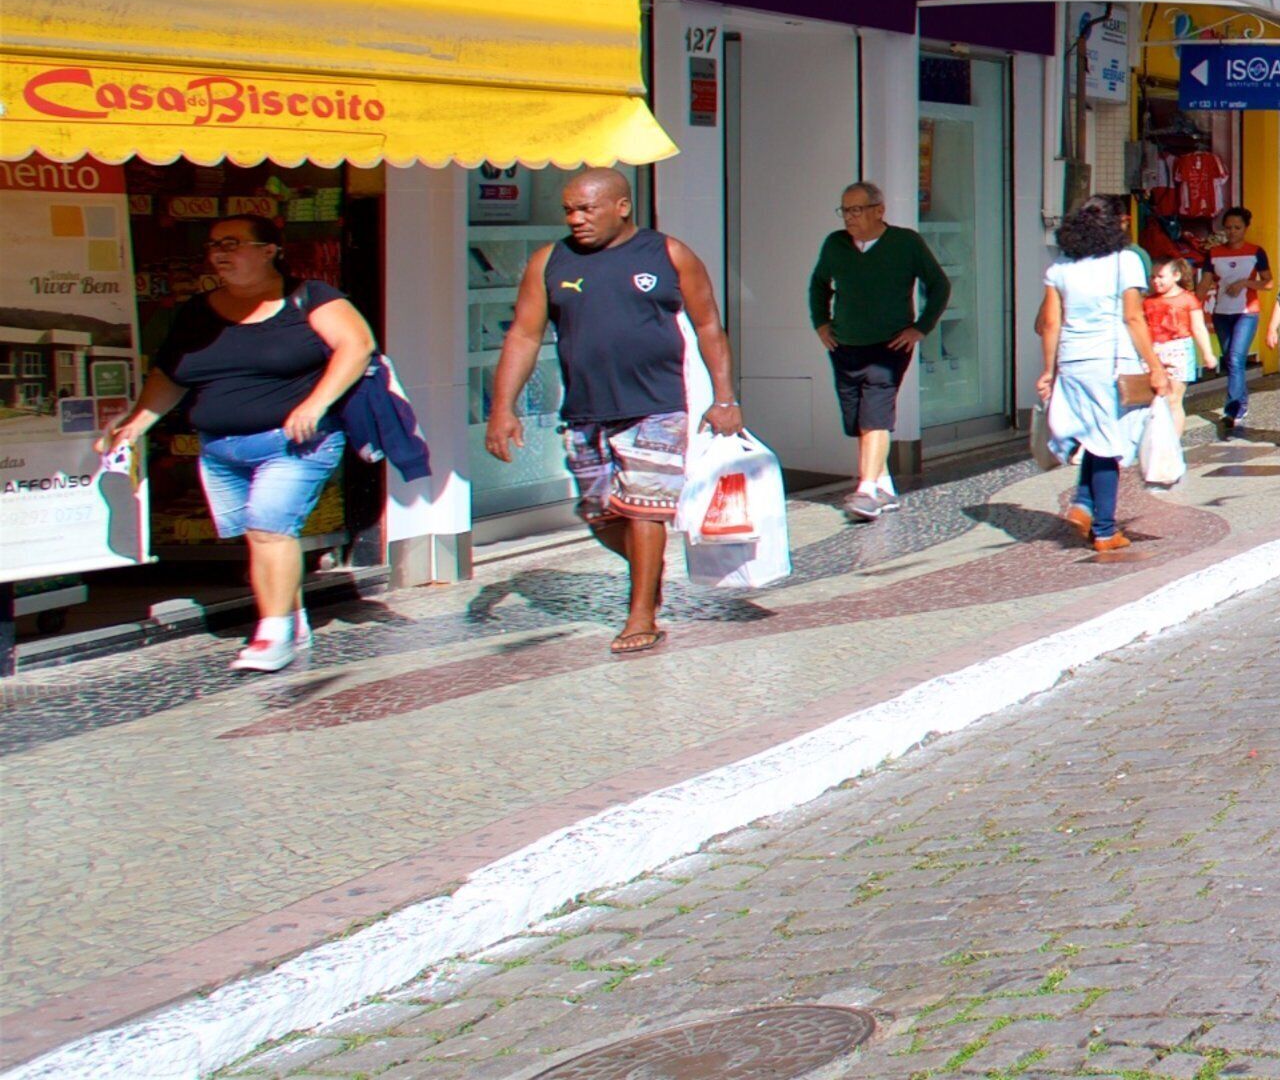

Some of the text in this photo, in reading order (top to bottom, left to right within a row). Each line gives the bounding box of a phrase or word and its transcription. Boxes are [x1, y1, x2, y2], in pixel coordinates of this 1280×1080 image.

[685, 26, 717, 53] 127
[23, 68, 386, 126] Casa do Biscoito
[30, 276, 78, 294] Viver
[80, 276, 120, 294] Bem
[3, 473, 92, 495] AFFONSO
